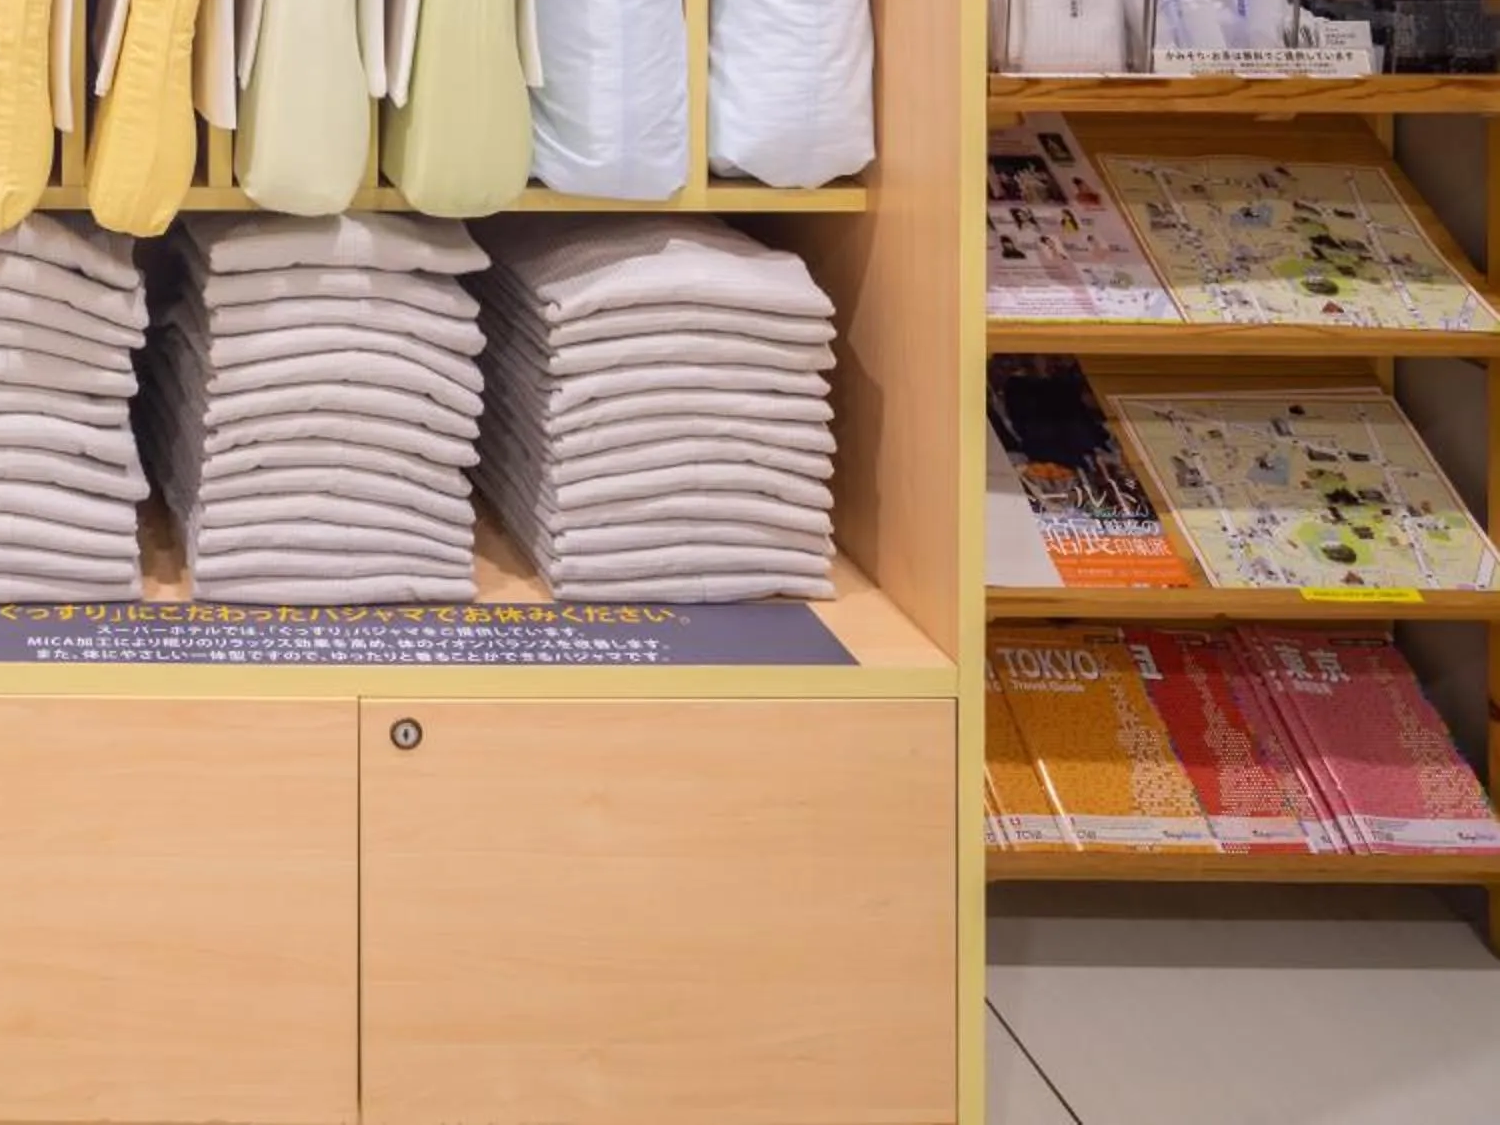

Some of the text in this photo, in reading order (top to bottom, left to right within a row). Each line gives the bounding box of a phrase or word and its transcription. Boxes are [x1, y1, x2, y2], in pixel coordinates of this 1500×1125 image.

[996, 648, 1099, 679] TOKYO
[1012, 679, 1085, 693] Travel Guide
